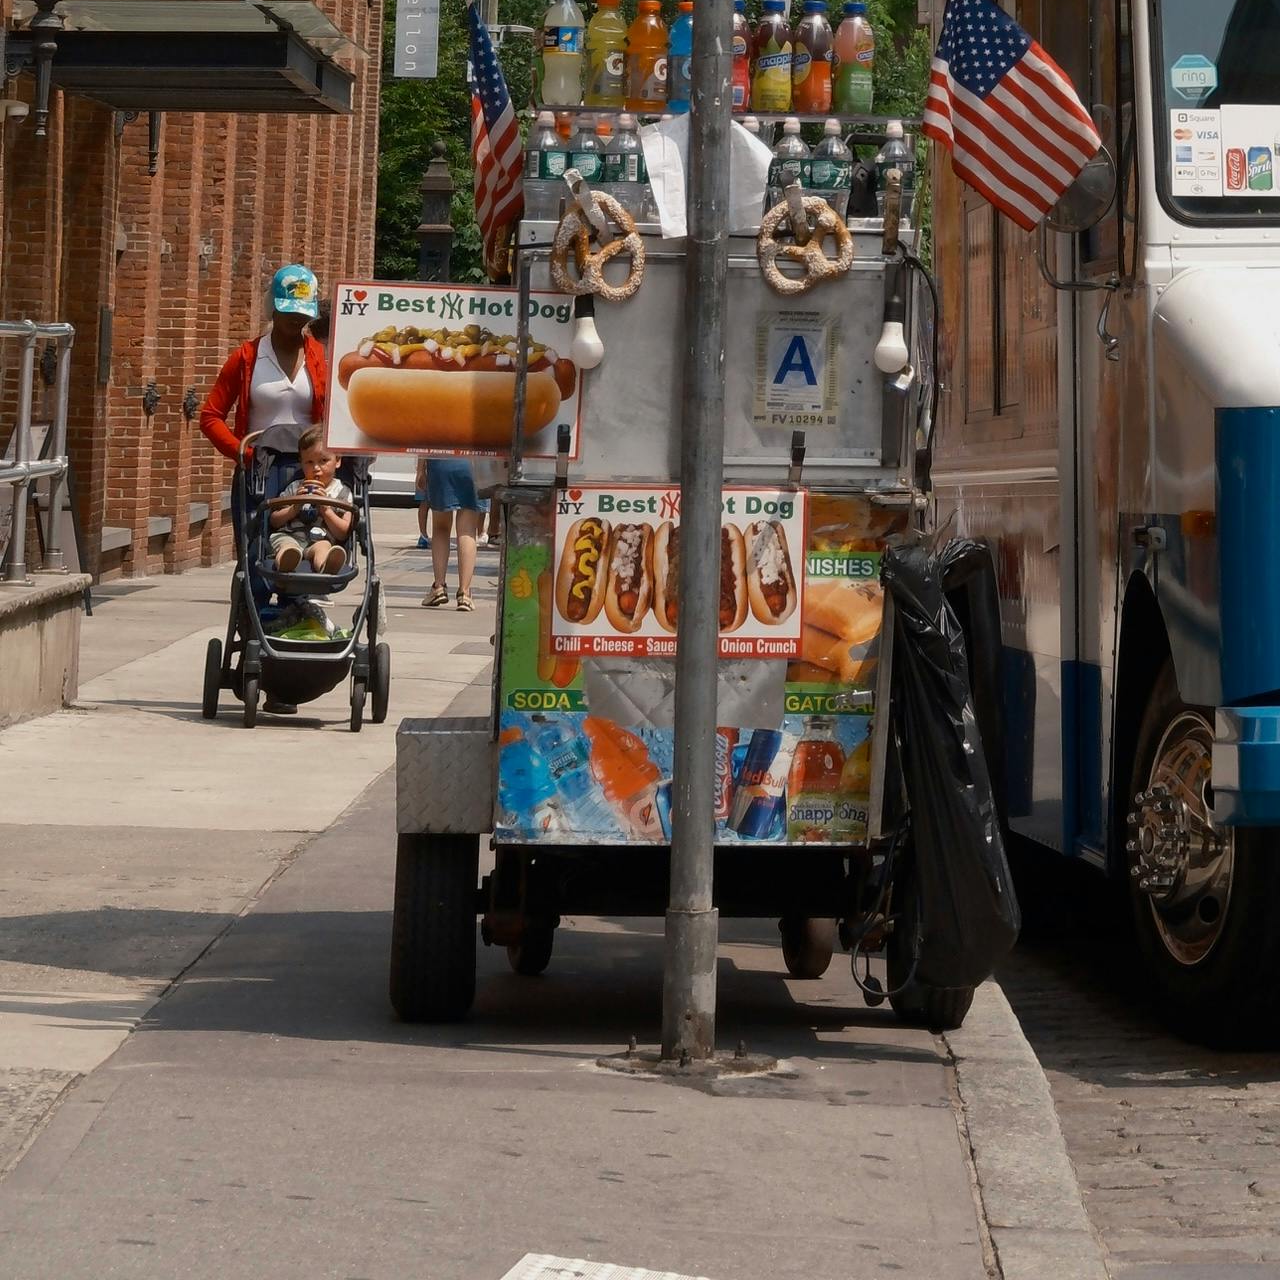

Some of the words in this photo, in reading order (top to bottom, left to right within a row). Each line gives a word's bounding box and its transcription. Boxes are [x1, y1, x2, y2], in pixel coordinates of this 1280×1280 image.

[1182, 71, 1207, 85] ring
[1189, 114, 1216, 123] Square
[1196, 131, 1219, 140] VISA
[341, 303, 369, 316] NY
[378, 293, 436, 313] Best
[469, 297, 513, 317] Hot
[526, 300, 570, 323] Dog
[773, 335, 818, 386] A
[557, 503, 584, 515] NY
[598, 494, 657, 513] Best
[745, 496, 794, 520] Dog
[806, 558, 874, 576] NISHES
[555, 636, 581, 652] Chili
[593, 637, 634, 653] Cheese
[721, 639, 753, 654] Onion
[757, 638, 797, 654] Crunch
[514, 692, 571, 709] SODA
[763, 771, 785, 789] Bull
